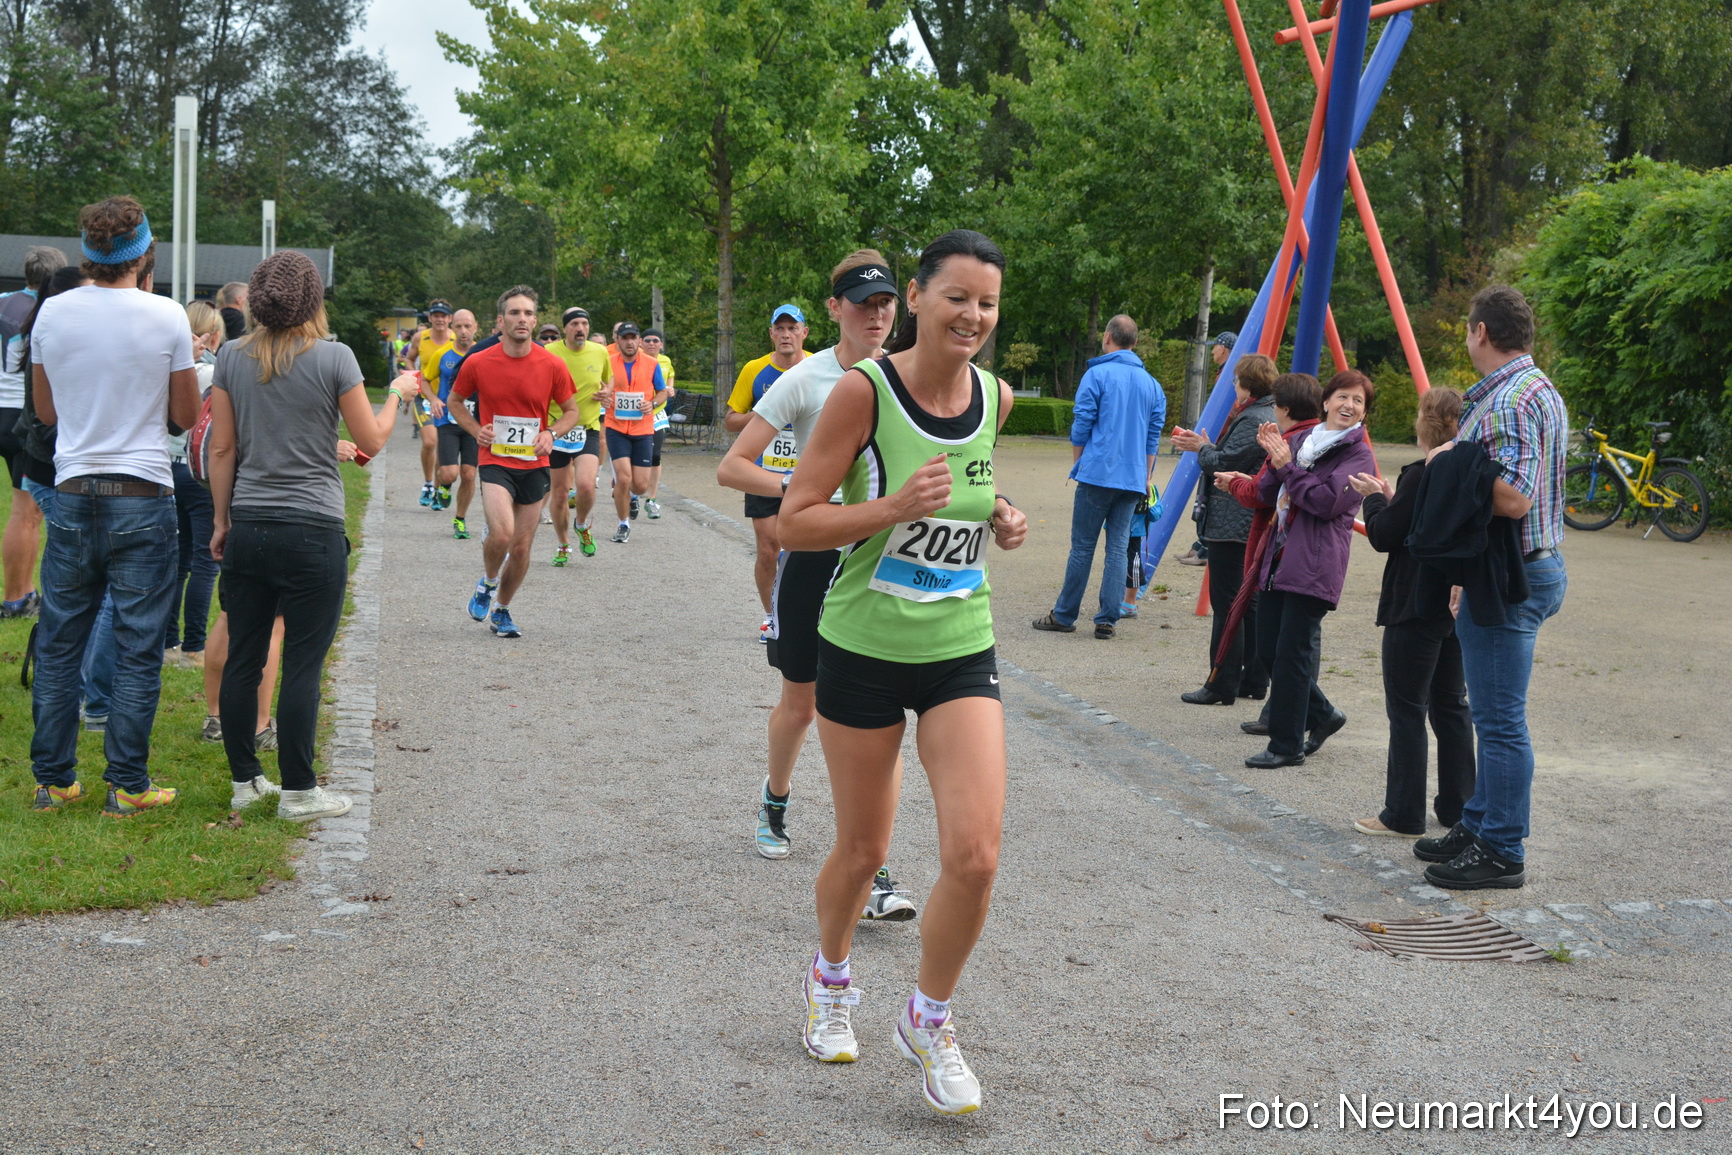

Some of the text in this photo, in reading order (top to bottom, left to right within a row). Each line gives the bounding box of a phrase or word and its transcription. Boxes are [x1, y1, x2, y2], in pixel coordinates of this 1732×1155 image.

[507, 427, 526, 444] 21
[897, 521, 984, 566] 2020
[913, 569, 953, 589] Silvia
